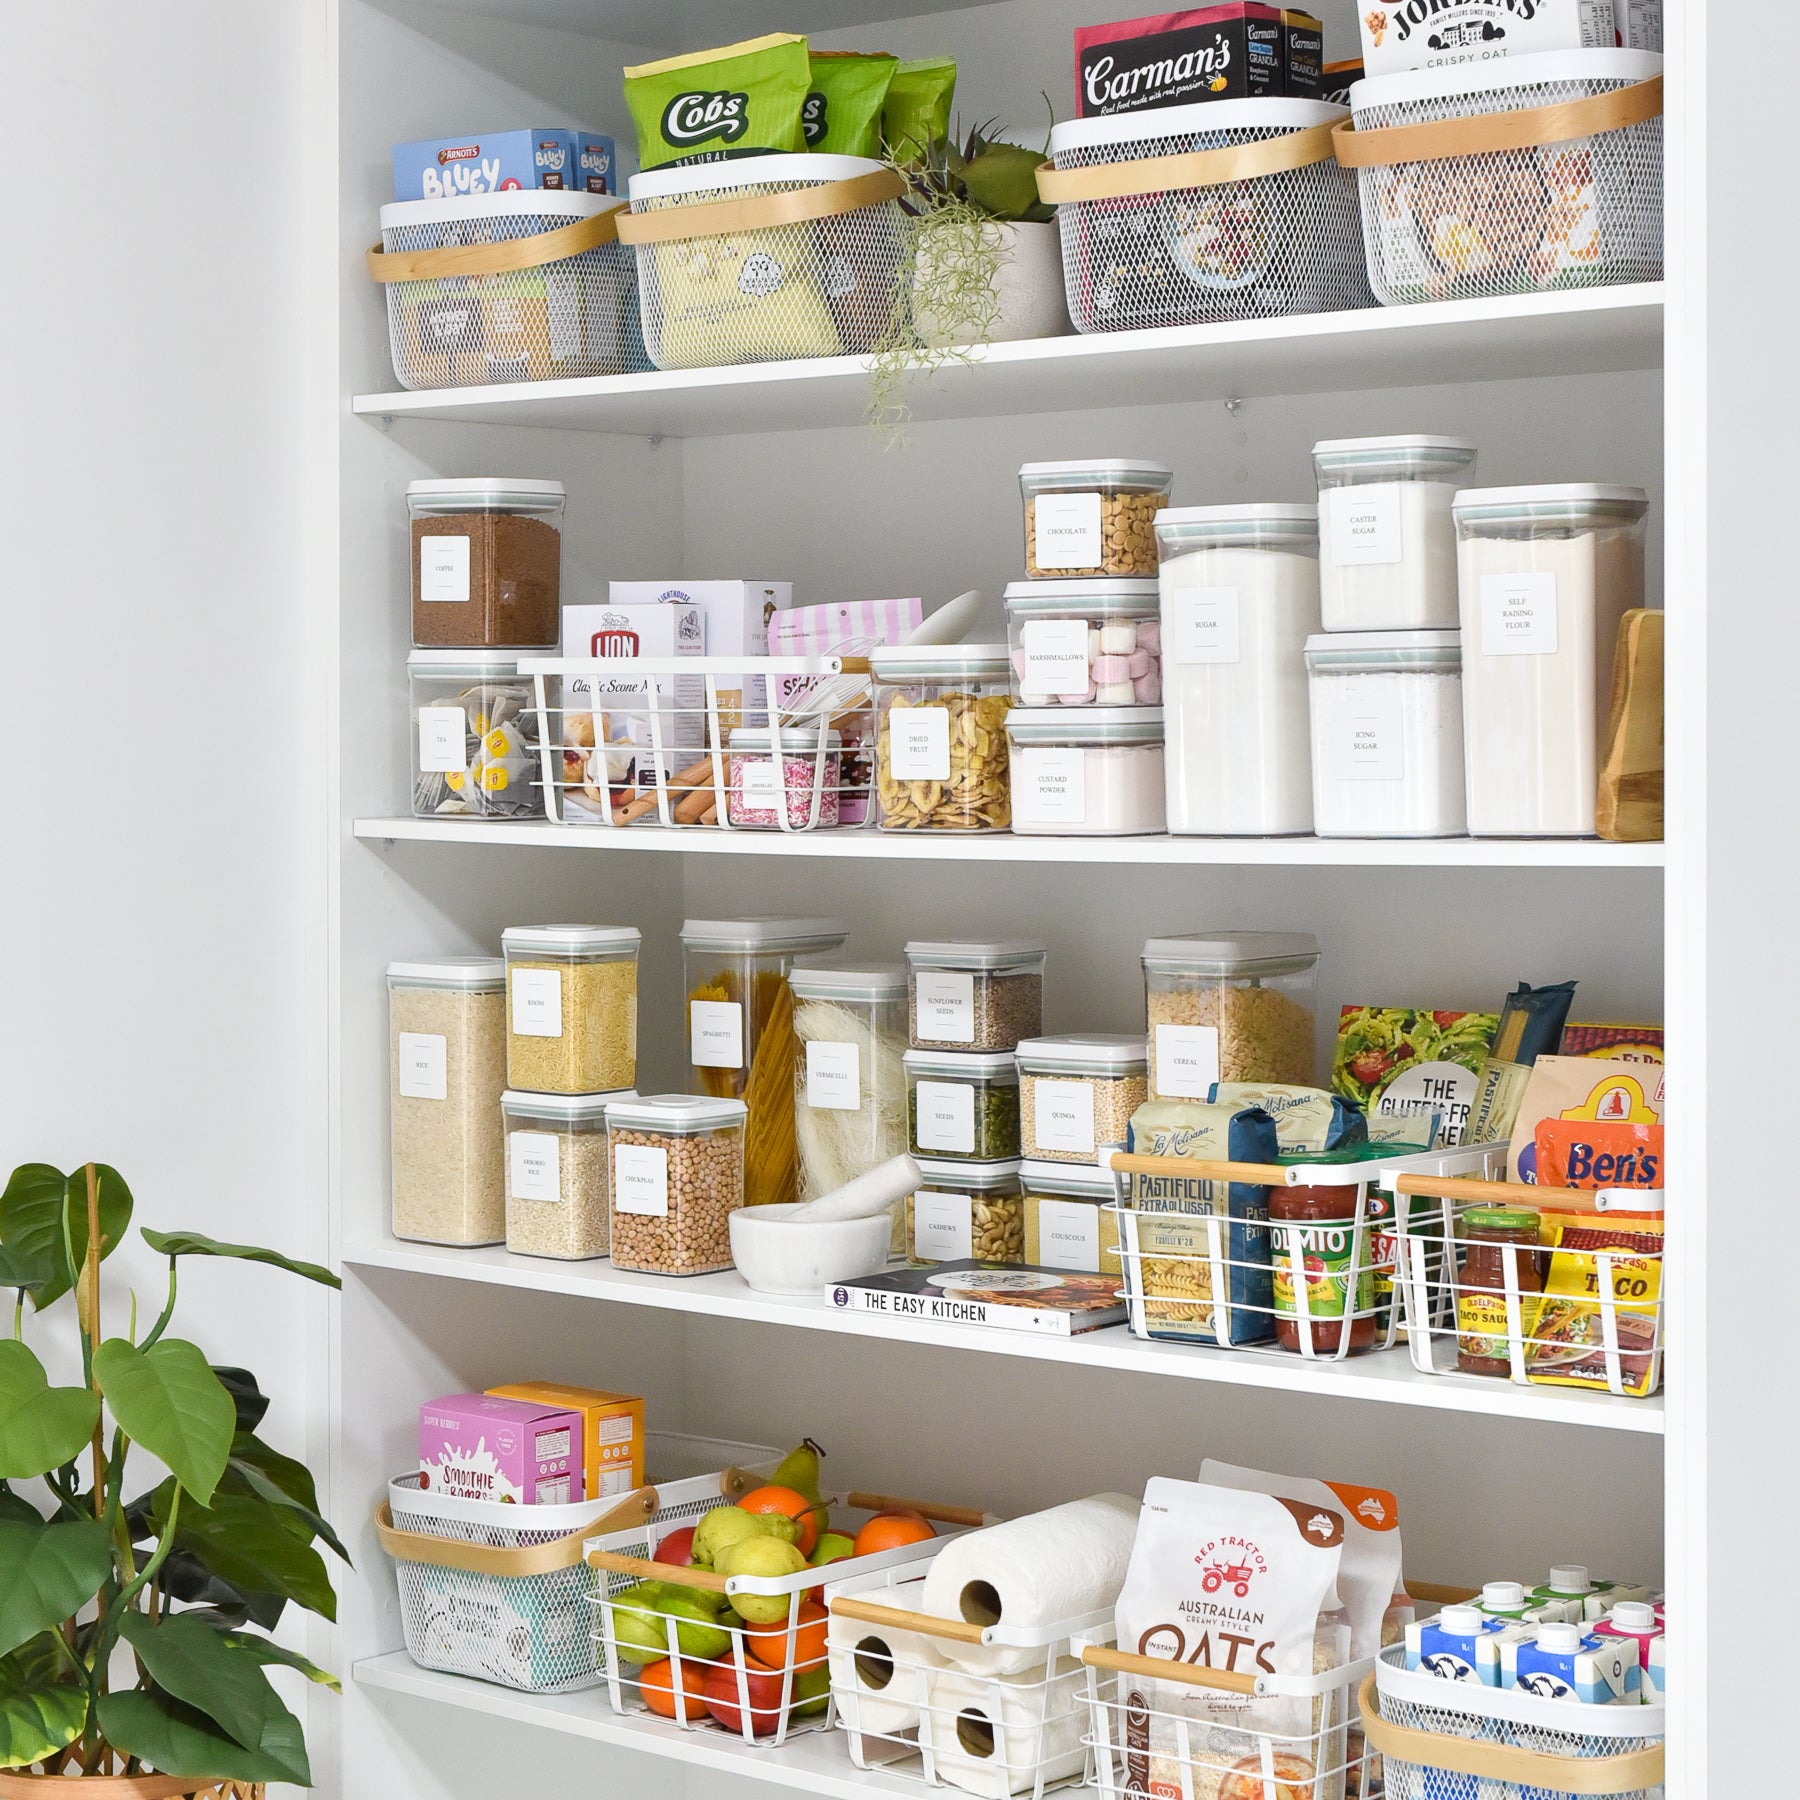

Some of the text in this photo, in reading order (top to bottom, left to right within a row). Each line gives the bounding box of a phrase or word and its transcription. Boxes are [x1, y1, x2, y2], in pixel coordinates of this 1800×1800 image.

[1430, 15, 1447, 28] FAMILY
[1448, 10, 1468, 19] MILLERS
[1249, 53, 1279, 67] GRANOLA
[1427, 48, 1508, 68] CRISPY OAT
[1084, 33, 1231, 106] Carman's
[1290, 61, 1320, 77] GRANOLA
[1100, 103, 1116, 116] Real
[1116, 99, 1131, 113] food
[1130, 94, 1148, 106] made
[1148, 90, 1162, 102] with
[1162, 85, 1176, 97] real
[675, 150, 729, 168] NATURAL
[422, 157, 500, 200] BLUEY
[1349, 515, 1378, 525] CASTER
[1046, 527, 1087, 536] CHOCOLATE
[1351, 526, 1377, 535] SUGAR
[657, 590, 692, 603] LIGHTHOUSE
[1507, 597, 1527, 608] SELF
[1502, 609, 1534, 618] RAISING
[1194, 620, 1219, 629] SUGAR
[1505, 621, 1531, 630] FLOUR
[1028, 653, 1085, 662] MARSHMALLOWS
[572, 678, 605, 694] Clasc
[606, 679, 638, 693] Scone
[908, 735, 929, 743] DRIED
[1355, 730, 1376, 739] ICING
[909, 745, 929, 753] FRUIT
[1352, 742, 1378, 750] SUGAR
[1037, 775, 1068, 783] CUSTARD
[1039, 786, 1066, 794] POWDER
[927, 997, 963, 1006] SUNFLOWER
[935, 1007, 954, 1015] SEEDS
[702, 1030, 731, 1039] SPAGHETTI
[415, 1061, 429, 1069] RICE
[1173, 1057, 1199, 1066] CEREAL
[815, 1070, 848, 1080] VERMICELLI
[1423, 1078, 1457, 1100] THE
[1472, 1069, 1502, 1136] PASTIFICIO
[934, 1112, 955, 1121] SEEDS
[1051, 1111, 1076, 1120] QUINOA
[1160, 1127, 1209, 1156] Molisana
[1566, 1142, 1658, 1184] Ben's
[527, 1168, 540, 1176] RICE
[624, 1175, 655, 1185] CHICKPEAS
[1140, 1174, 1214, 1200] PASTIFICIO
[928, 1223, 957, 1232] CASHEWS
[1050, 1232, 1086, 1242] COUSCOUS
[1270, 1227, 1346, 1253] OLMIO
[1585, 1272, 1648, 1297] TCO
[865, 1292, 986, 1322] THE EASY KITCHEN
[1460, 1309, 1479, 1322] TACO
[424, 1415, 460, 1431] SUPER BERRIES
[443, 1464, 495, 1490] SMOOTHIE
[1194, 1536, 1268, 1574] RED TRACTOR
[1178, 1600, 1265, 1625] AUSTRALIAN
[1185, 1615, 1250, 1632] CREAMY STYLE
[1138, 1623, 1276, 1674] OATS
[1147, 1640, 1178, 1652] INSTANT
